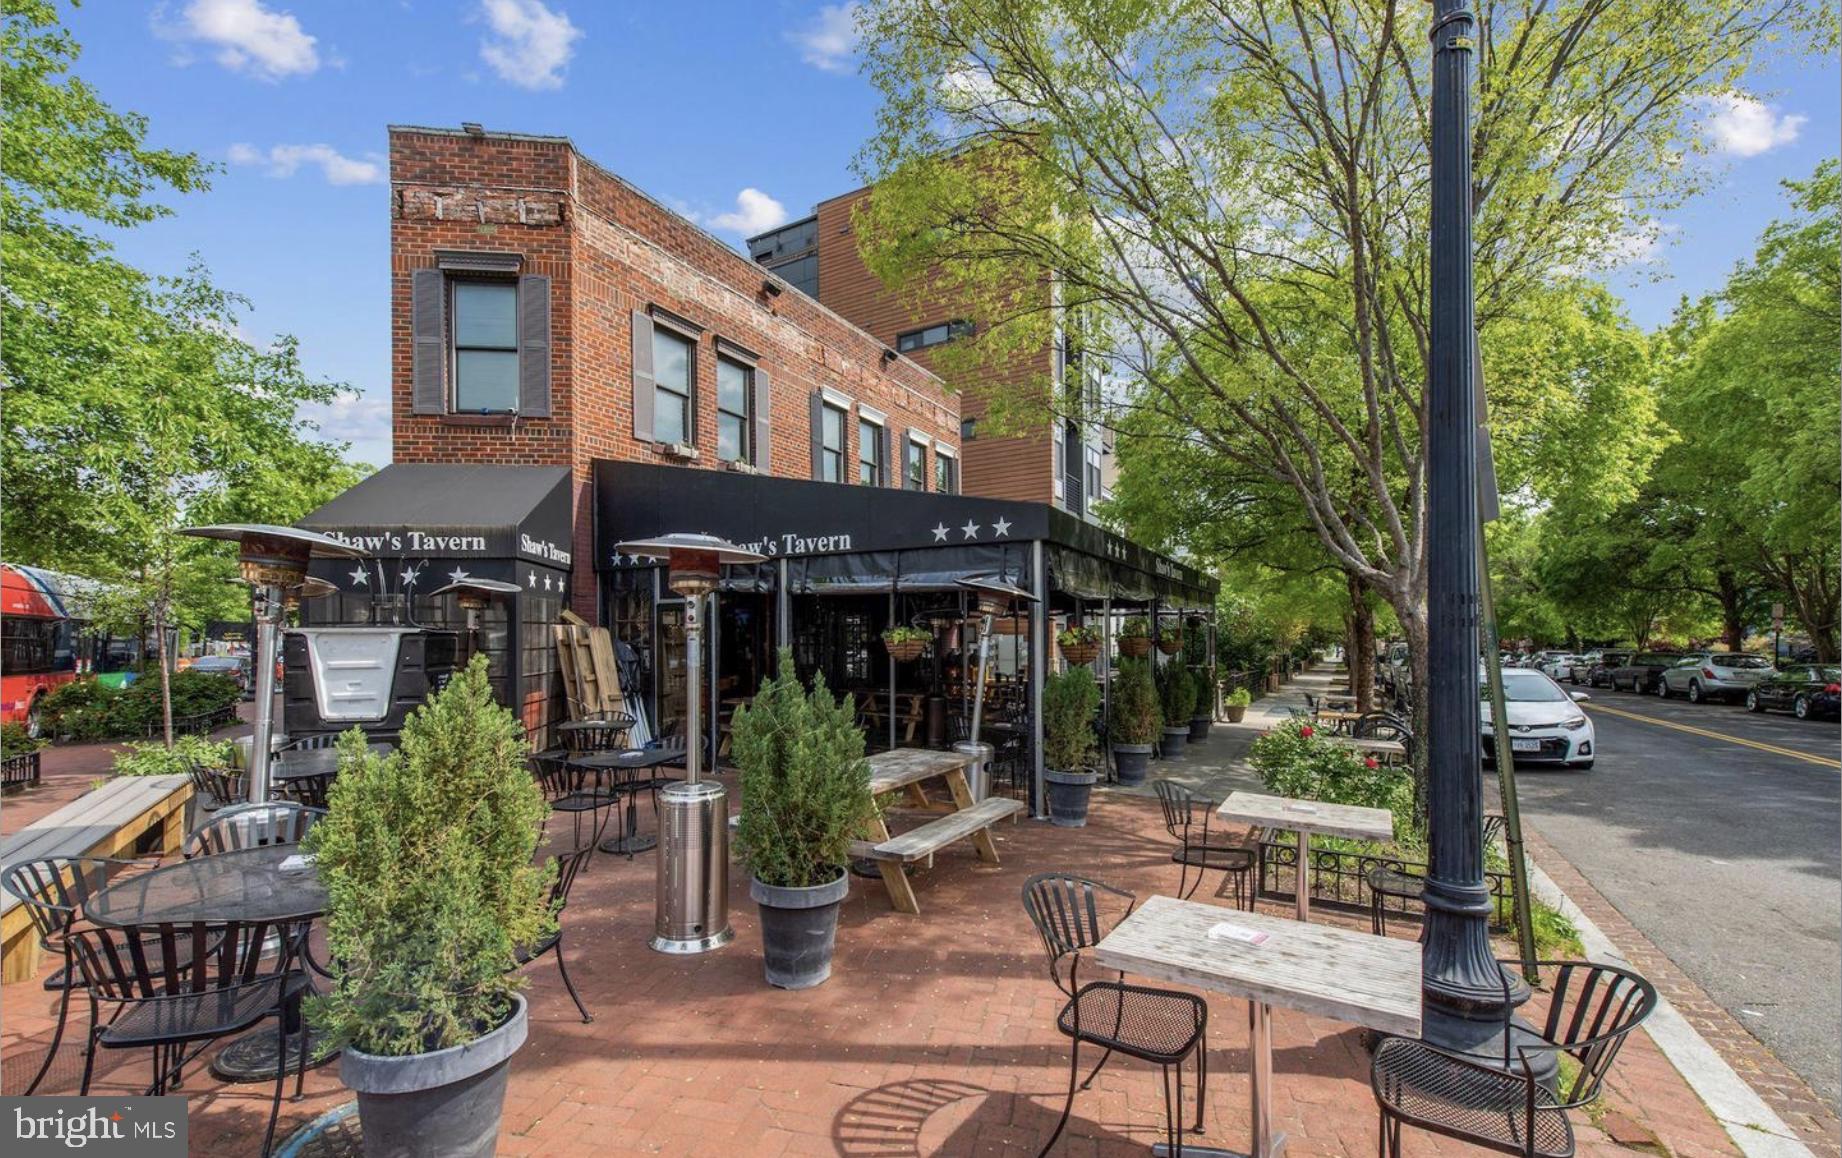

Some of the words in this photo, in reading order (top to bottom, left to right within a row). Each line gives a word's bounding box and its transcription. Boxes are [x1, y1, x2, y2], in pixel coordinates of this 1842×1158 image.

[406, 531, 487, 551] Tavern
[521, 532, 549, 558] Shaw's
[548, 542, 571, 565] Tavern
[727, 536, 777, 556] aw's
[782, 533, 851, 555] Tavern
